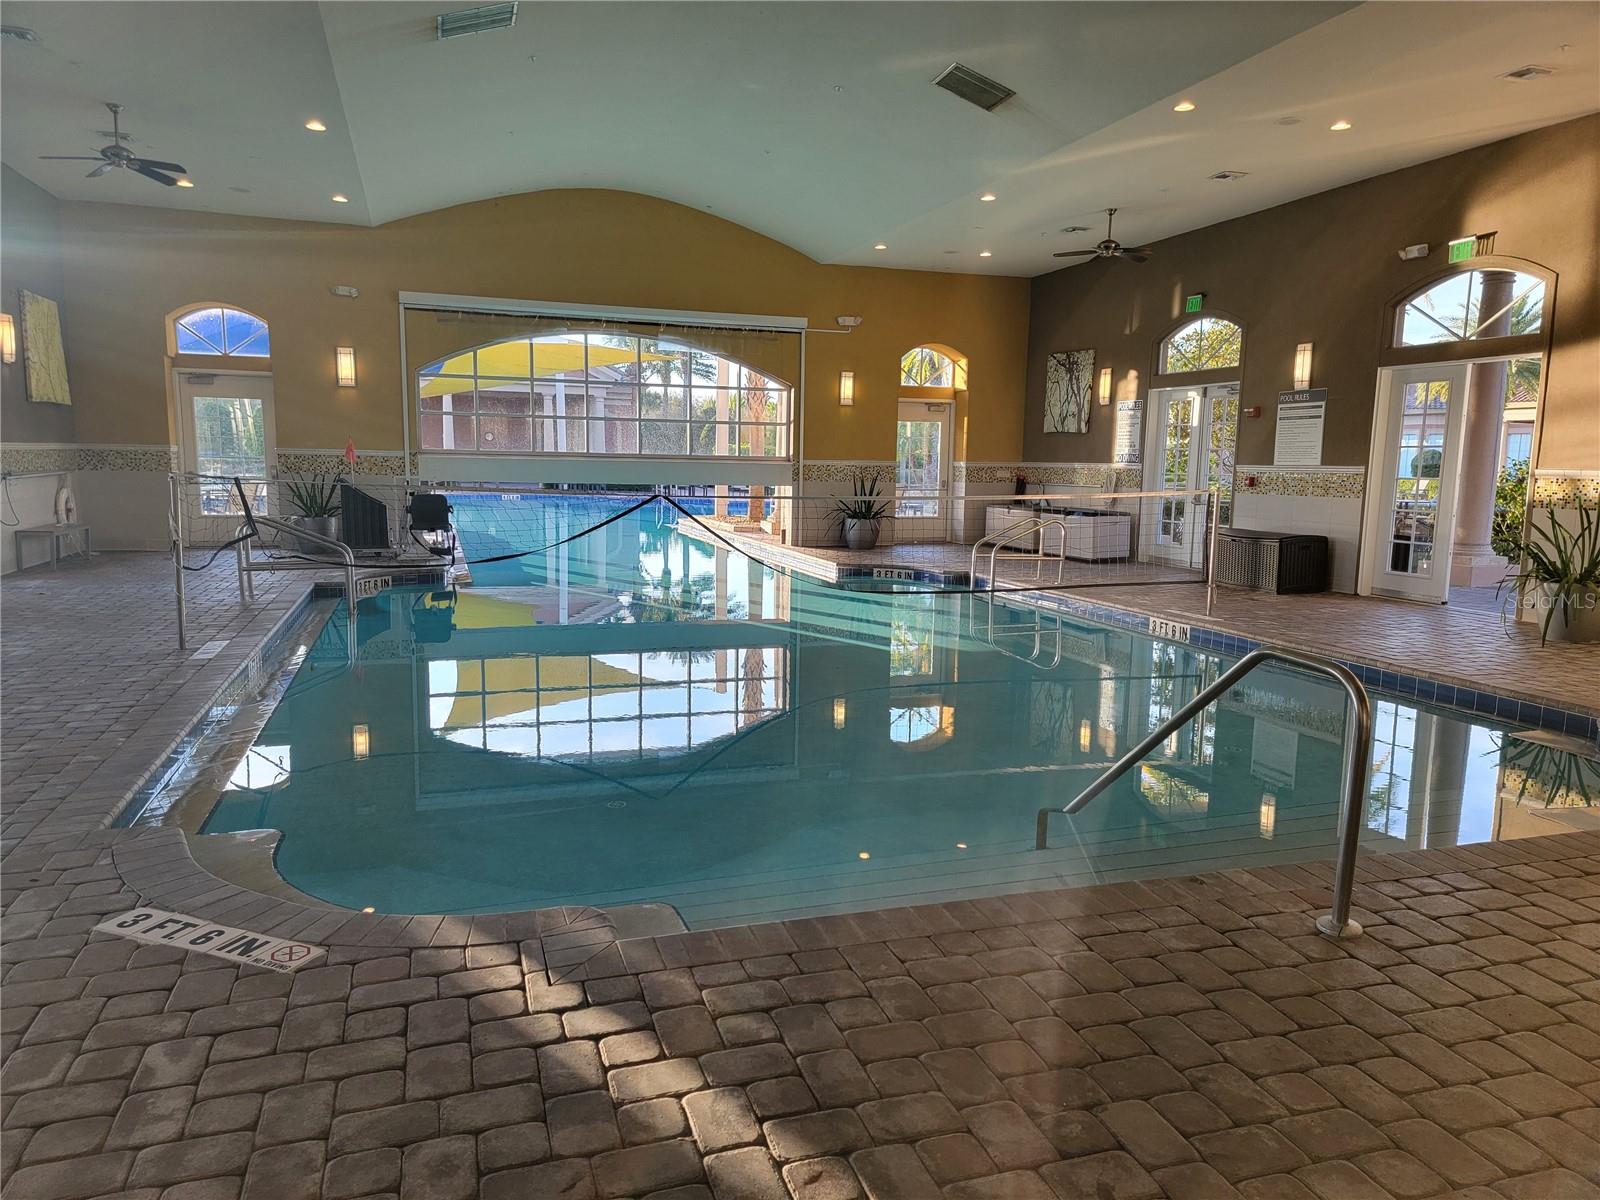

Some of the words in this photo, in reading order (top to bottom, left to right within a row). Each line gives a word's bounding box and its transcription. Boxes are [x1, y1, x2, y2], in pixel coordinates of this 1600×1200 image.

[1453, 241, 1473, 261] EXIT
[1188, 298, 1201, 311] EXIT
[1295, 393, 1310, 401] RULES
[885, 570, 894, 578] FT
[897, 571, 902, 579] 6
[904, 571, 912, 580] IN
[380, 578, 390, 589] IN
[1152, 620, 1157, 633] 3
[1171, 624, 1177, 638] 6
[117, 913, 153, 929] 3
[188, 929, 226, 946] 6
[262, 960, 292, 971] DIVING
